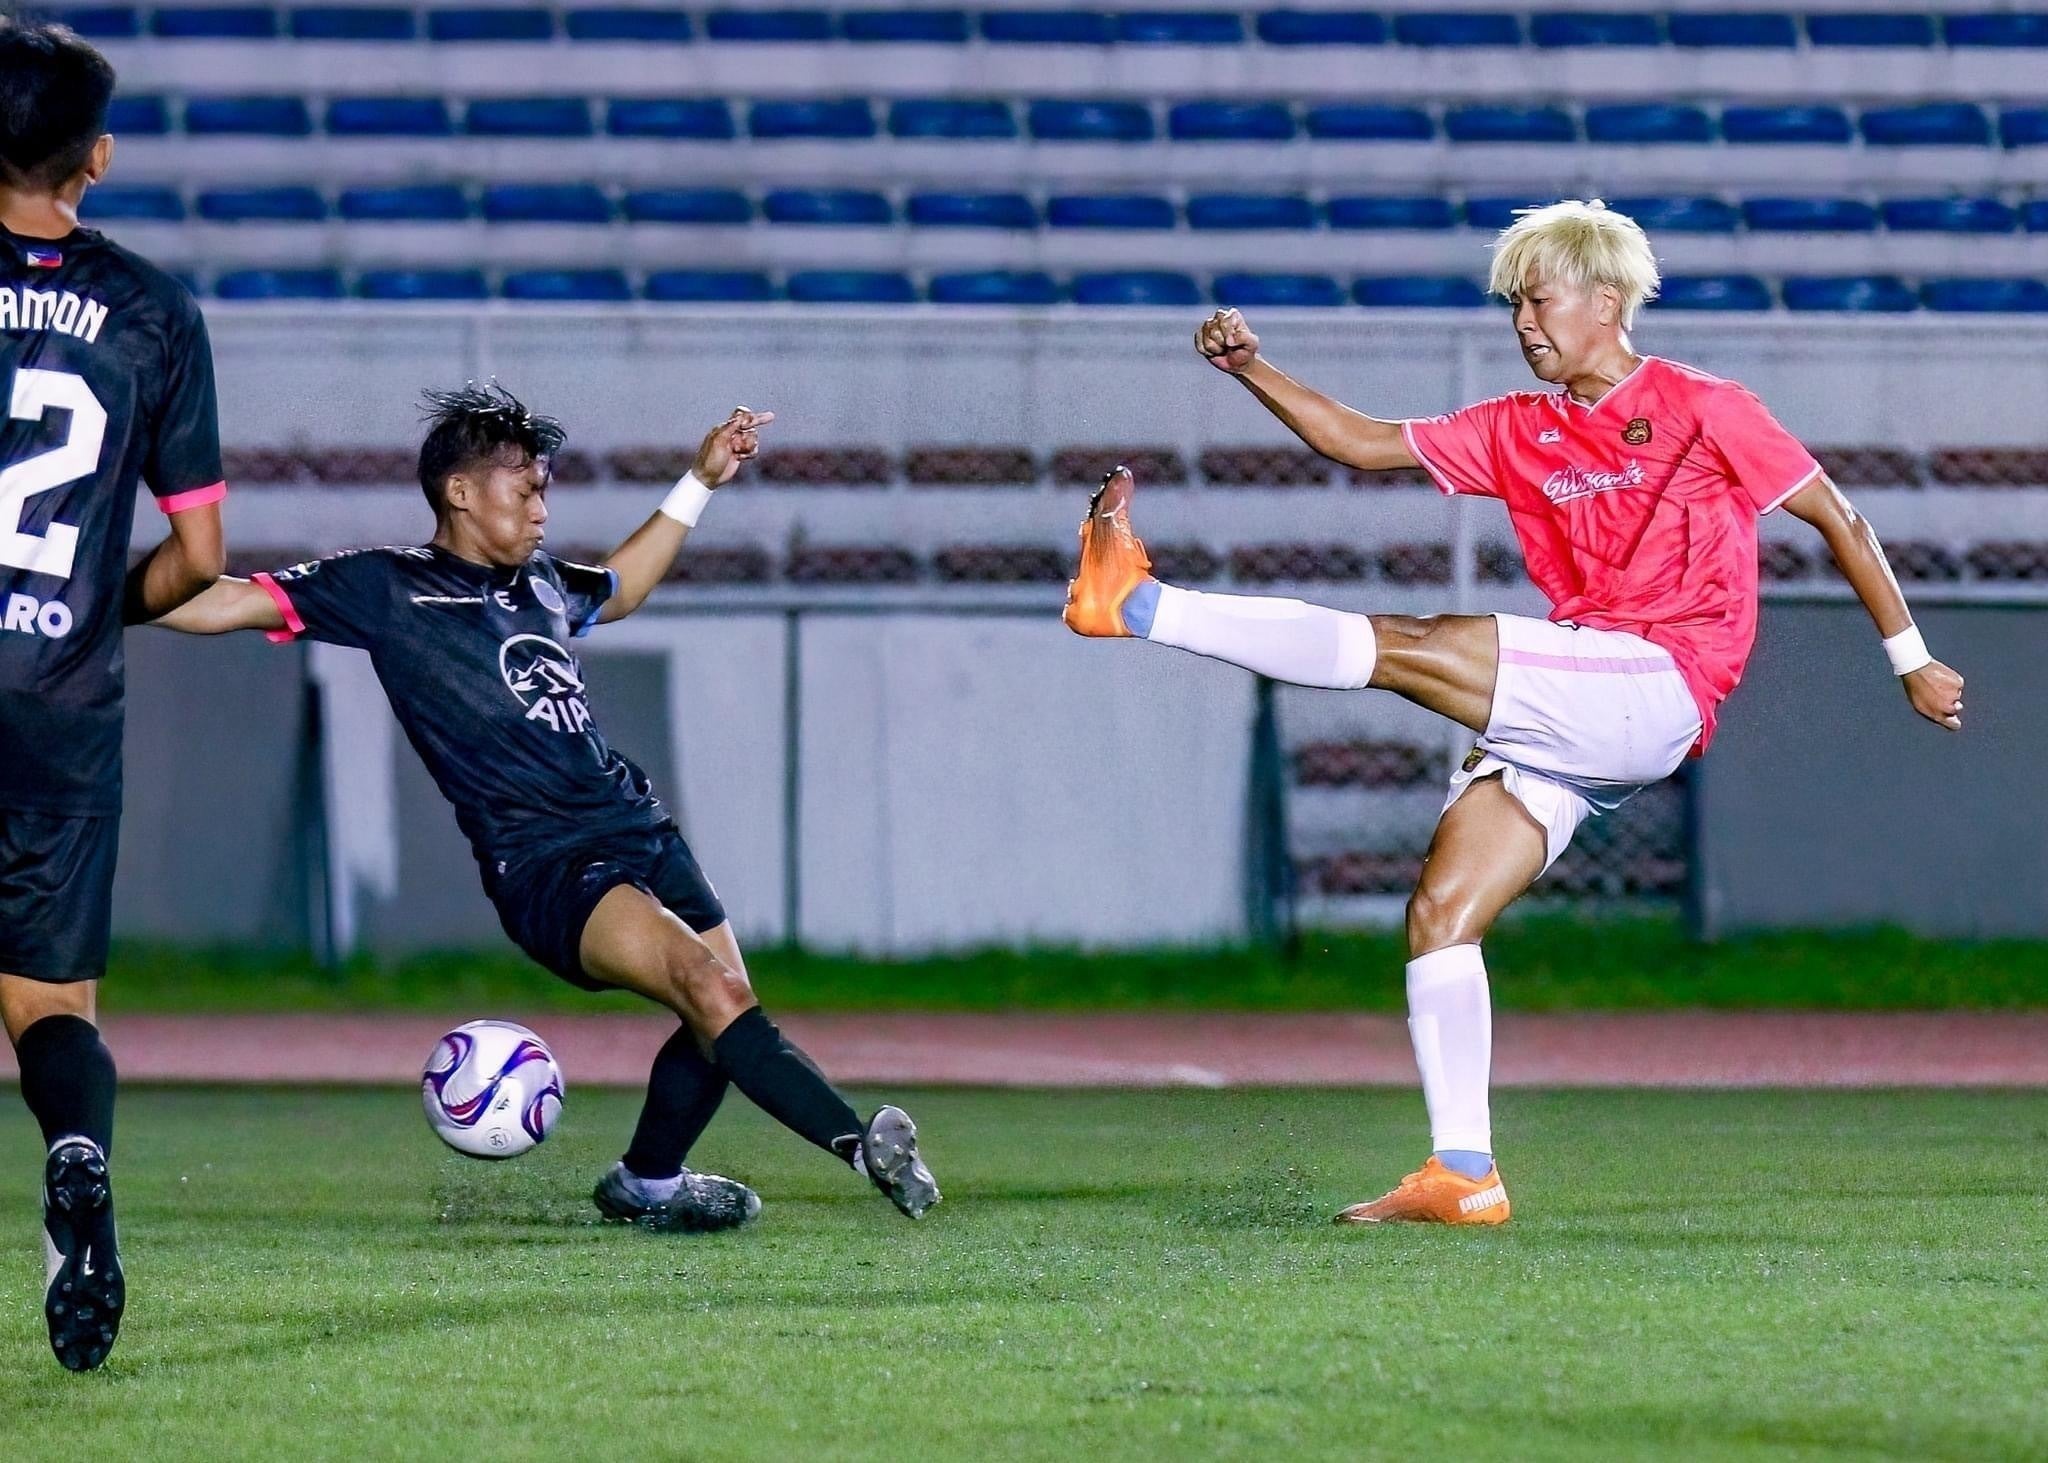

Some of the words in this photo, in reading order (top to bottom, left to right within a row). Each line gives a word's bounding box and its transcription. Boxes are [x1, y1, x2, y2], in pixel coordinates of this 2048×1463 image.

[0, 367, 108, 579] 2
[0, 592, 73, 639] RO
[525, 696, 592, 733] AIA
